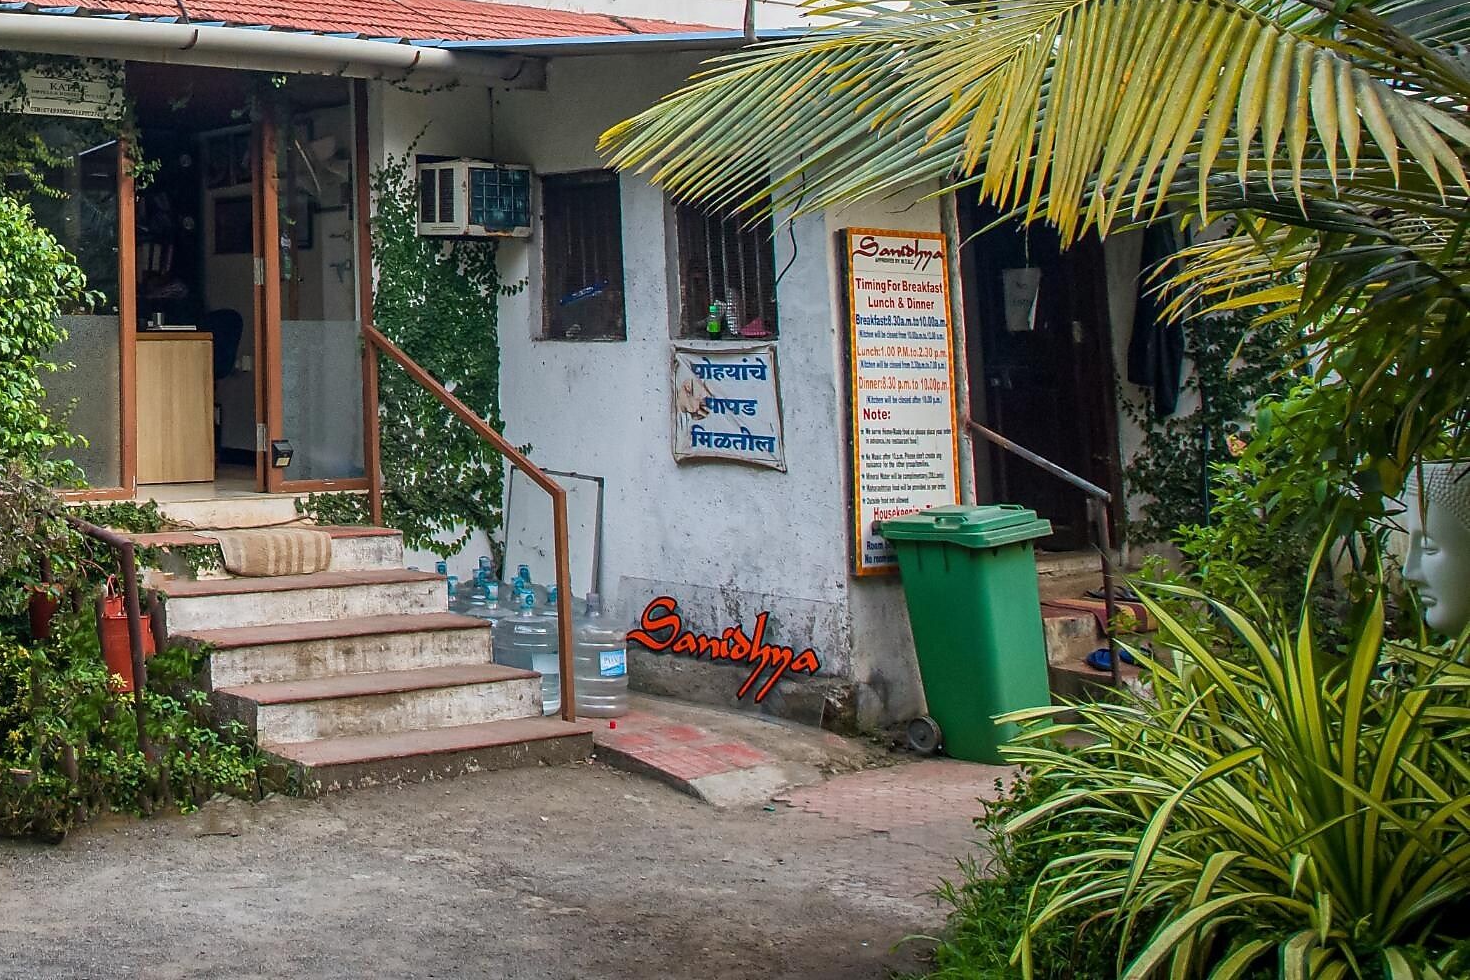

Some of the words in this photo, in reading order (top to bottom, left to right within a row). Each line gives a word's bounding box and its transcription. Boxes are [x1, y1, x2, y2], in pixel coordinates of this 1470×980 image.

[855, 278, 887, 293] Timing
[887, 279, 901, 291] For
[901, 280, 943, 294] Breakfast
[868, 296, 895, 308] Lunch
[898, 297, 905, 308] &
[907, 298, 935, 310] Dinner
[863, 408, 890, 420] Note:
